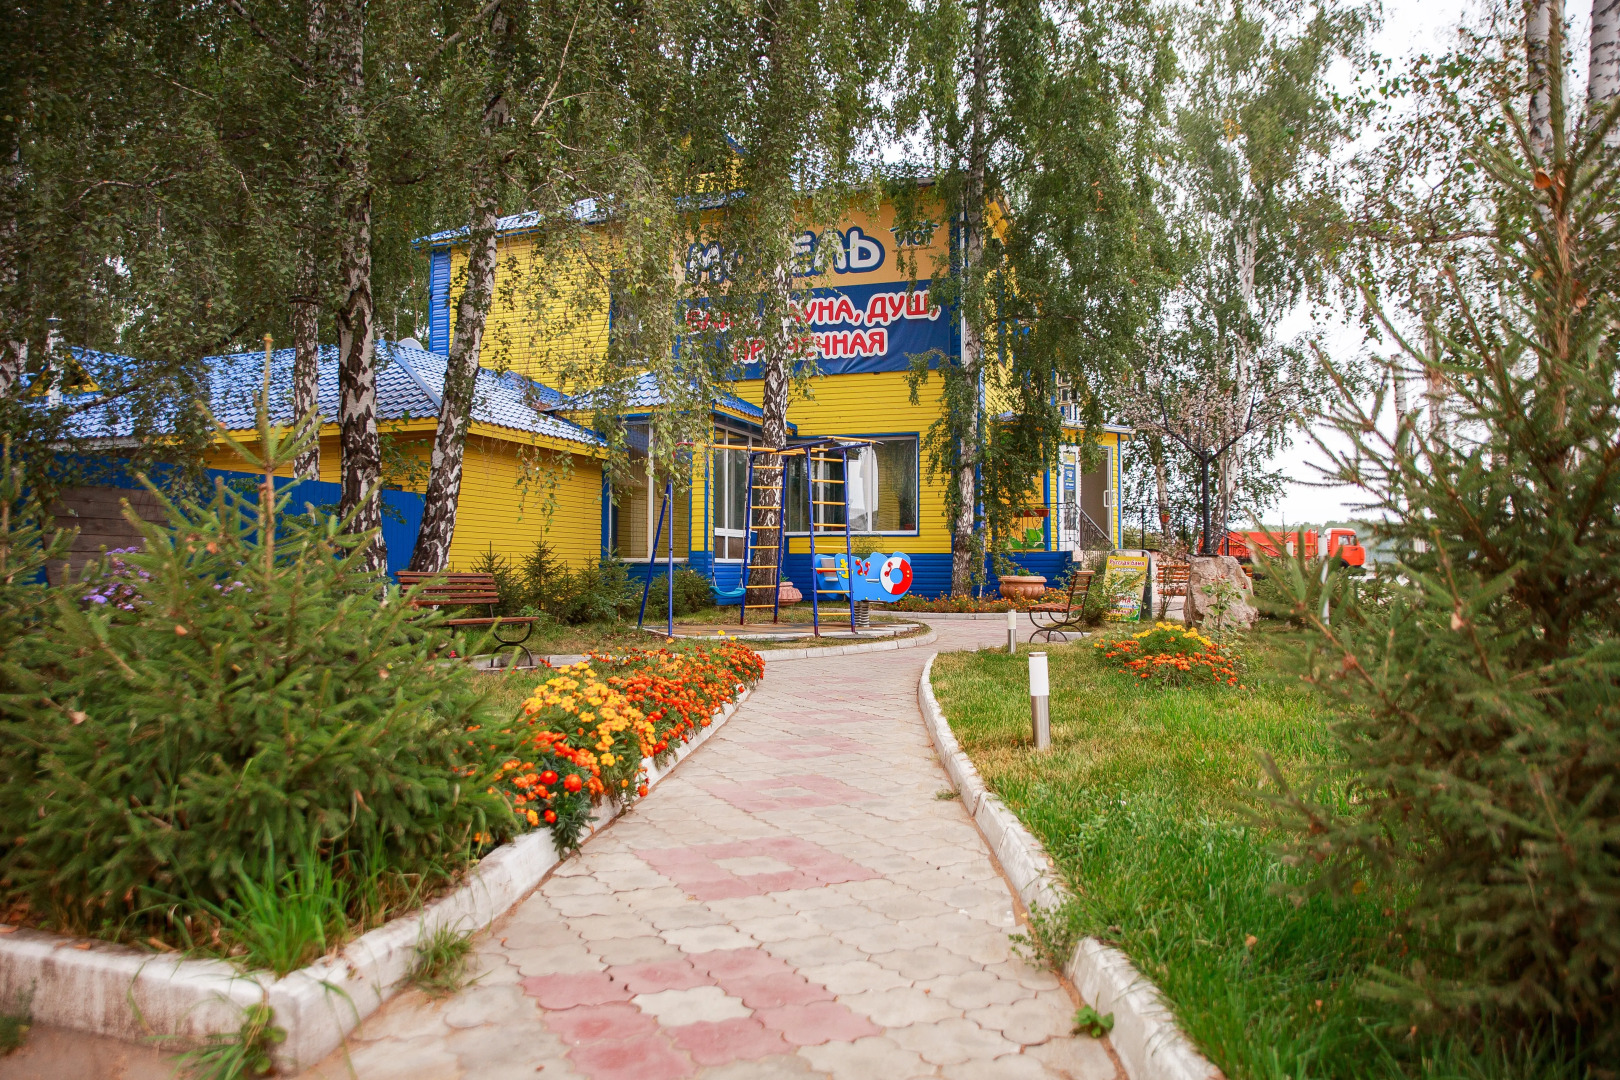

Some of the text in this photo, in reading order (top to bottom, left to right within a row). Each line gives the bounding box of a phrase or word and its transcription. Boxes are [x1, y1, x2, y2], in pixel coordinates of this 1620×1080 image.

[686, 228, 884, 283] МЕЛЬ
[866, 292, 939, 324] ДУШ,
[732, 330, 886, 363] ПРЧЕЧНАЯ
[1109, 559, 1130, 567] Русская
